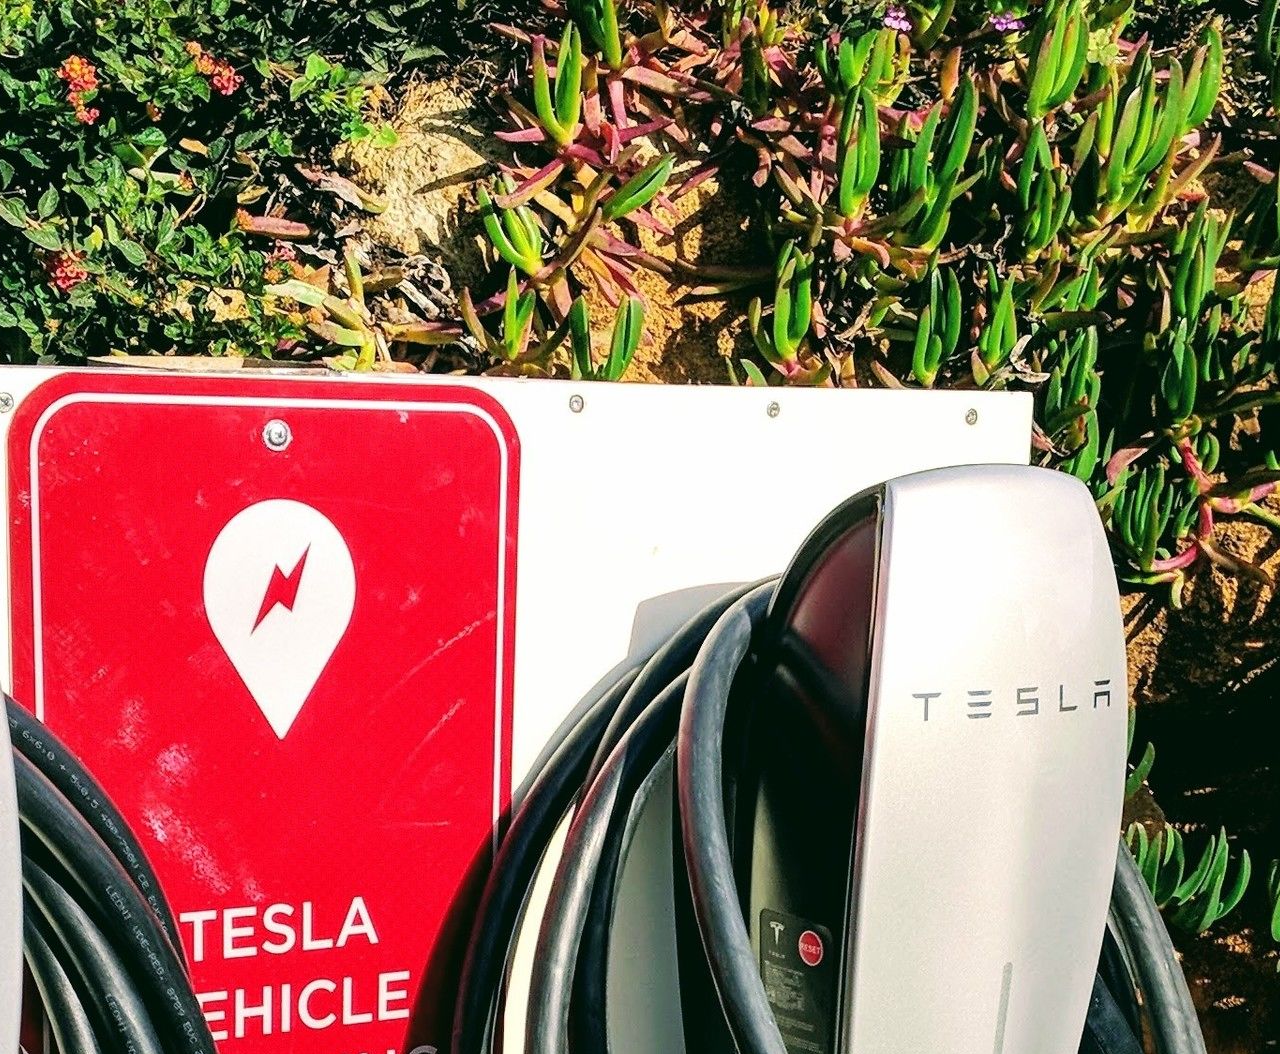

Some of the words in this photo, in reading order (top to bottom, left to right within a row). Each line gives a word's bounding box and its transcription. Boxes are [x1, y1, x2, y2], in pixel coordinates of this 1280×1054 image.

[912, 679, 1111, 722] TESLA
[179, 896, 379, 962] TESLA
[195, 970, 411, 1042] EHICLE
